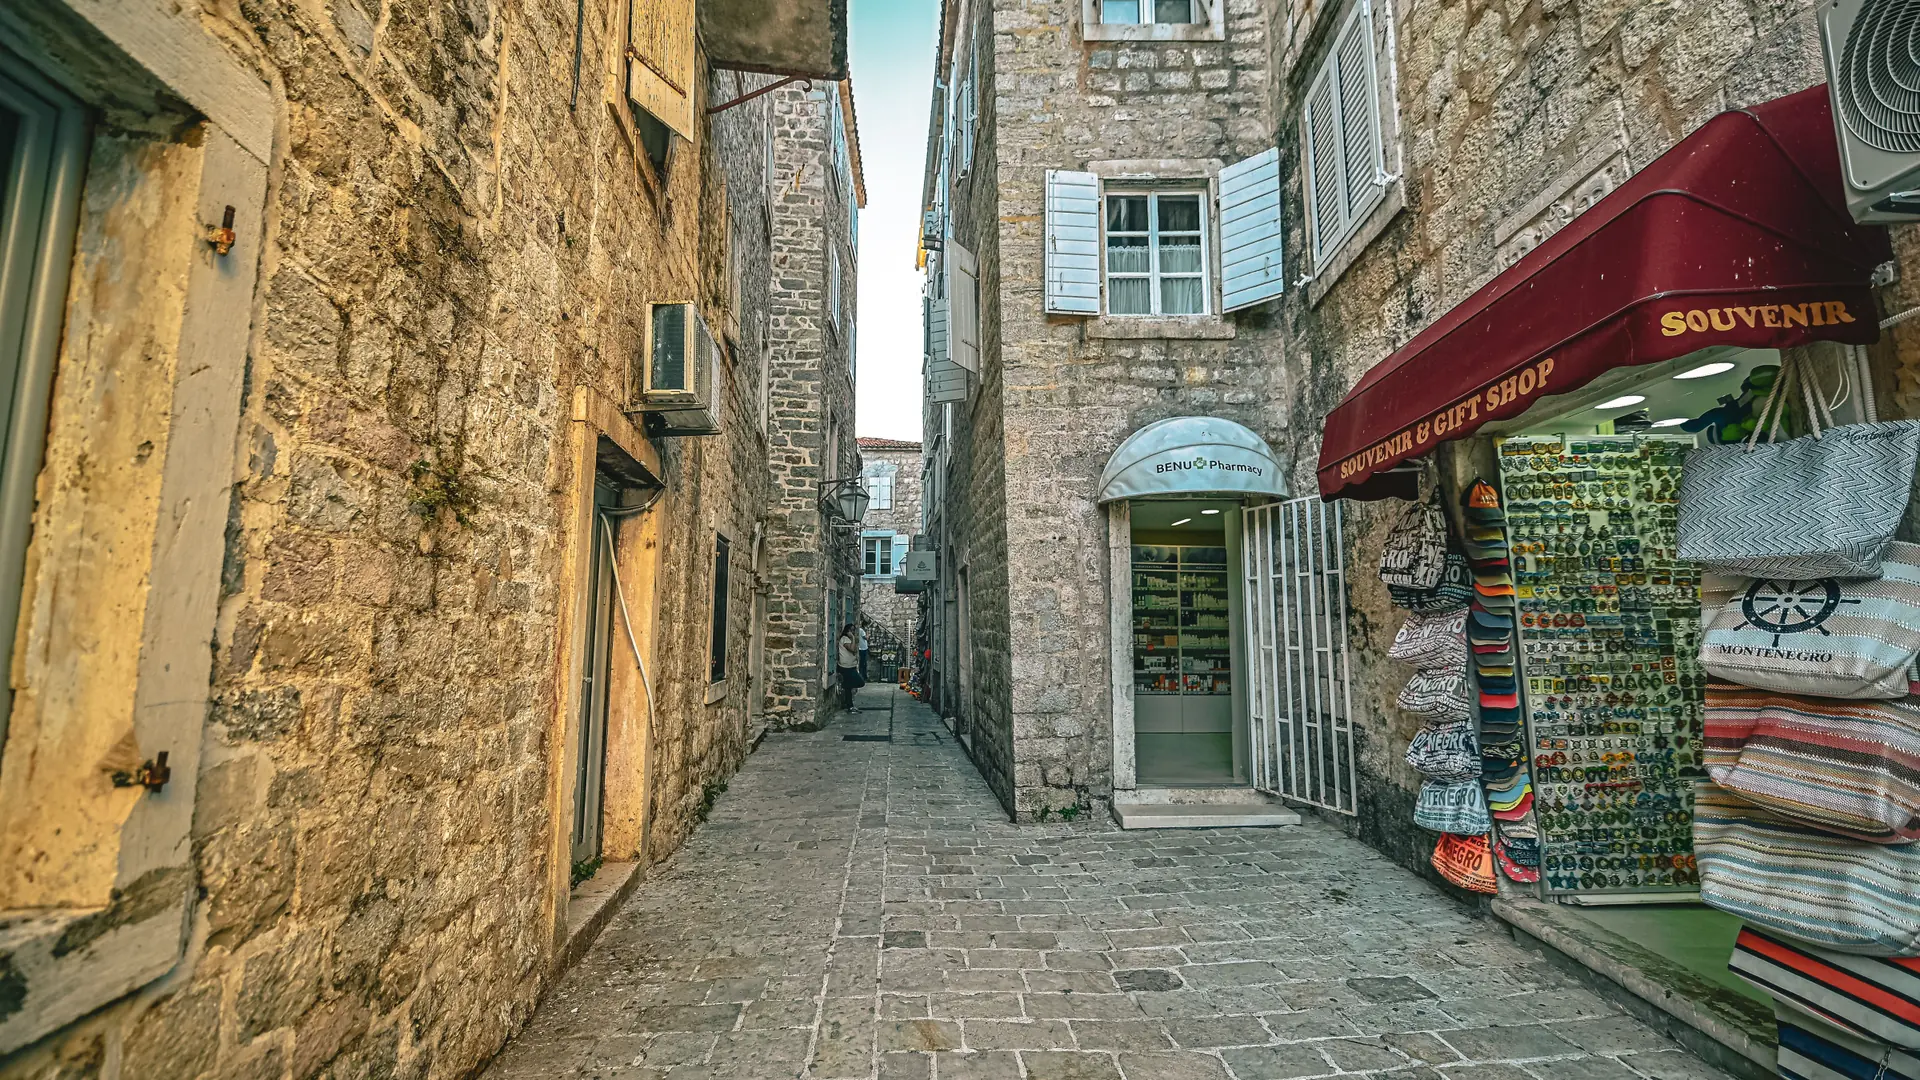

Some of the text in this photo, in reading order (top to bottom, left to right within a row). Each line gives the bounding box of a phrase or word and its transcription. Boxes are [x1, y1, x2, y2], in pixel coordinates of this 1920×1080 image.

[1660, 301, 1856, 337] SOUVENIR
[1340, 357, 1555, 480] SOUVENIR & GIFT SHOP
[1156, 460, 1263, 477] BENU Pharmacy
[1719, 645, 1832, 663] MONTENEGRO
